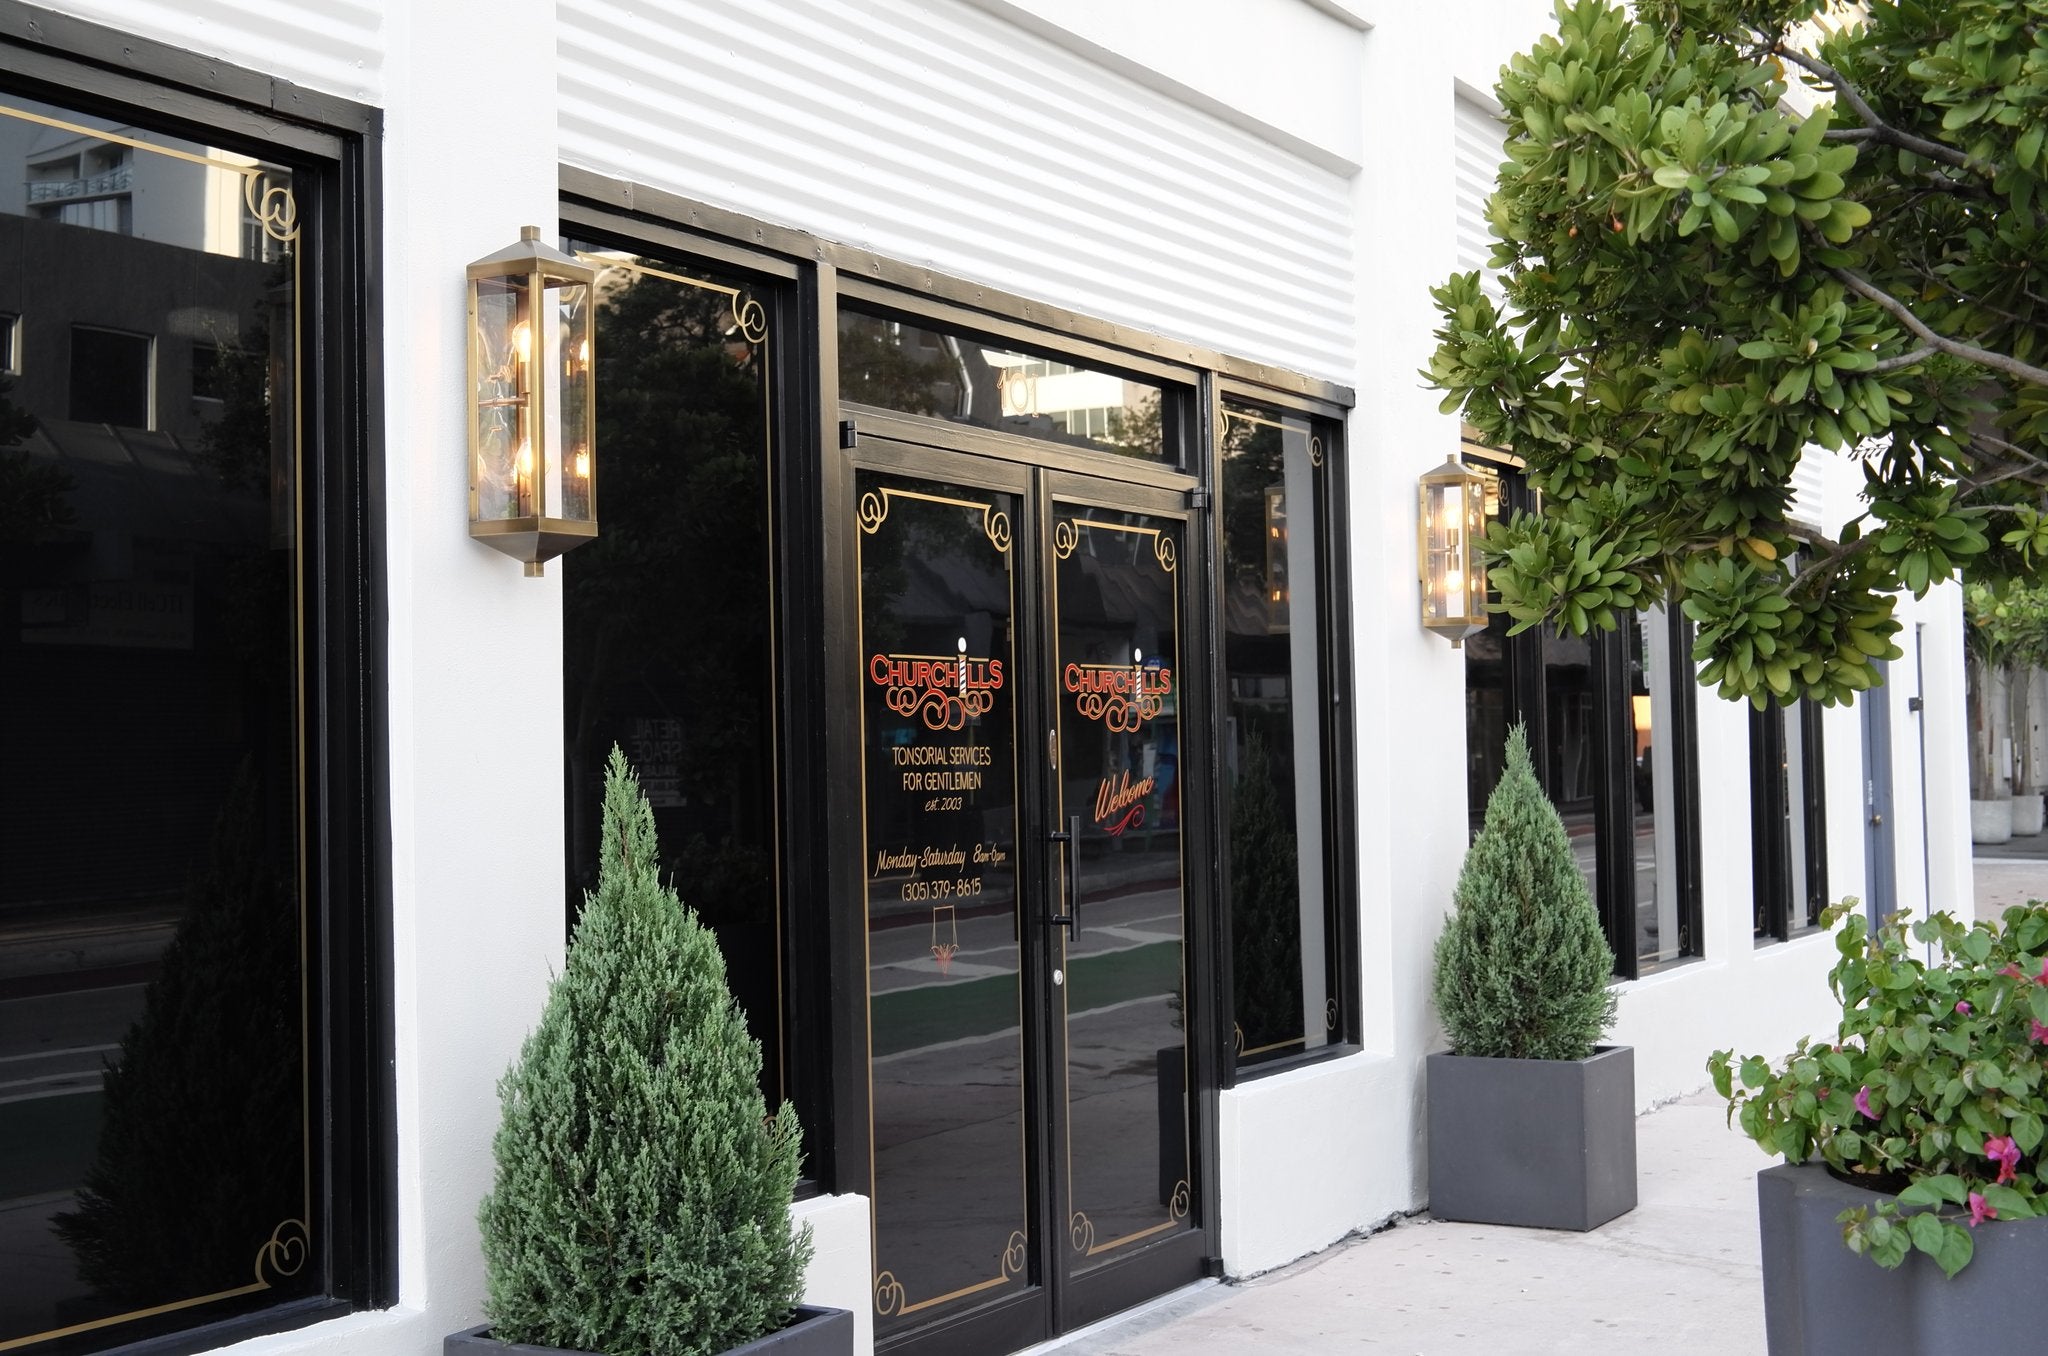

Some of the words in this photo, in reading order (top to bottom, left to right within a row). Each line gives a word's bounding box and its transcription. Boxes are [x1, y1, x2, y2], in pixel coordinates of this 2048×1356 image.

[996, 366, 1040, 418] 101
[870, 637, 1004, 698] CHURCHILLS
[1064, 648, 1172, 701] CHURCHILLS
[892, 746, 948, 766] TONSORIAL
[949, 746, 992, 766] SERVICES
[903, 772, 923, 791] FOR
[924, 771, 982, 791] GENTLEMEN
[1095, 768, 1154, 823] Welcome
[924, 798, 940, 812] est.
[941, 797, 963, 811] 2003
[902, 882, 930, 902] (305)
